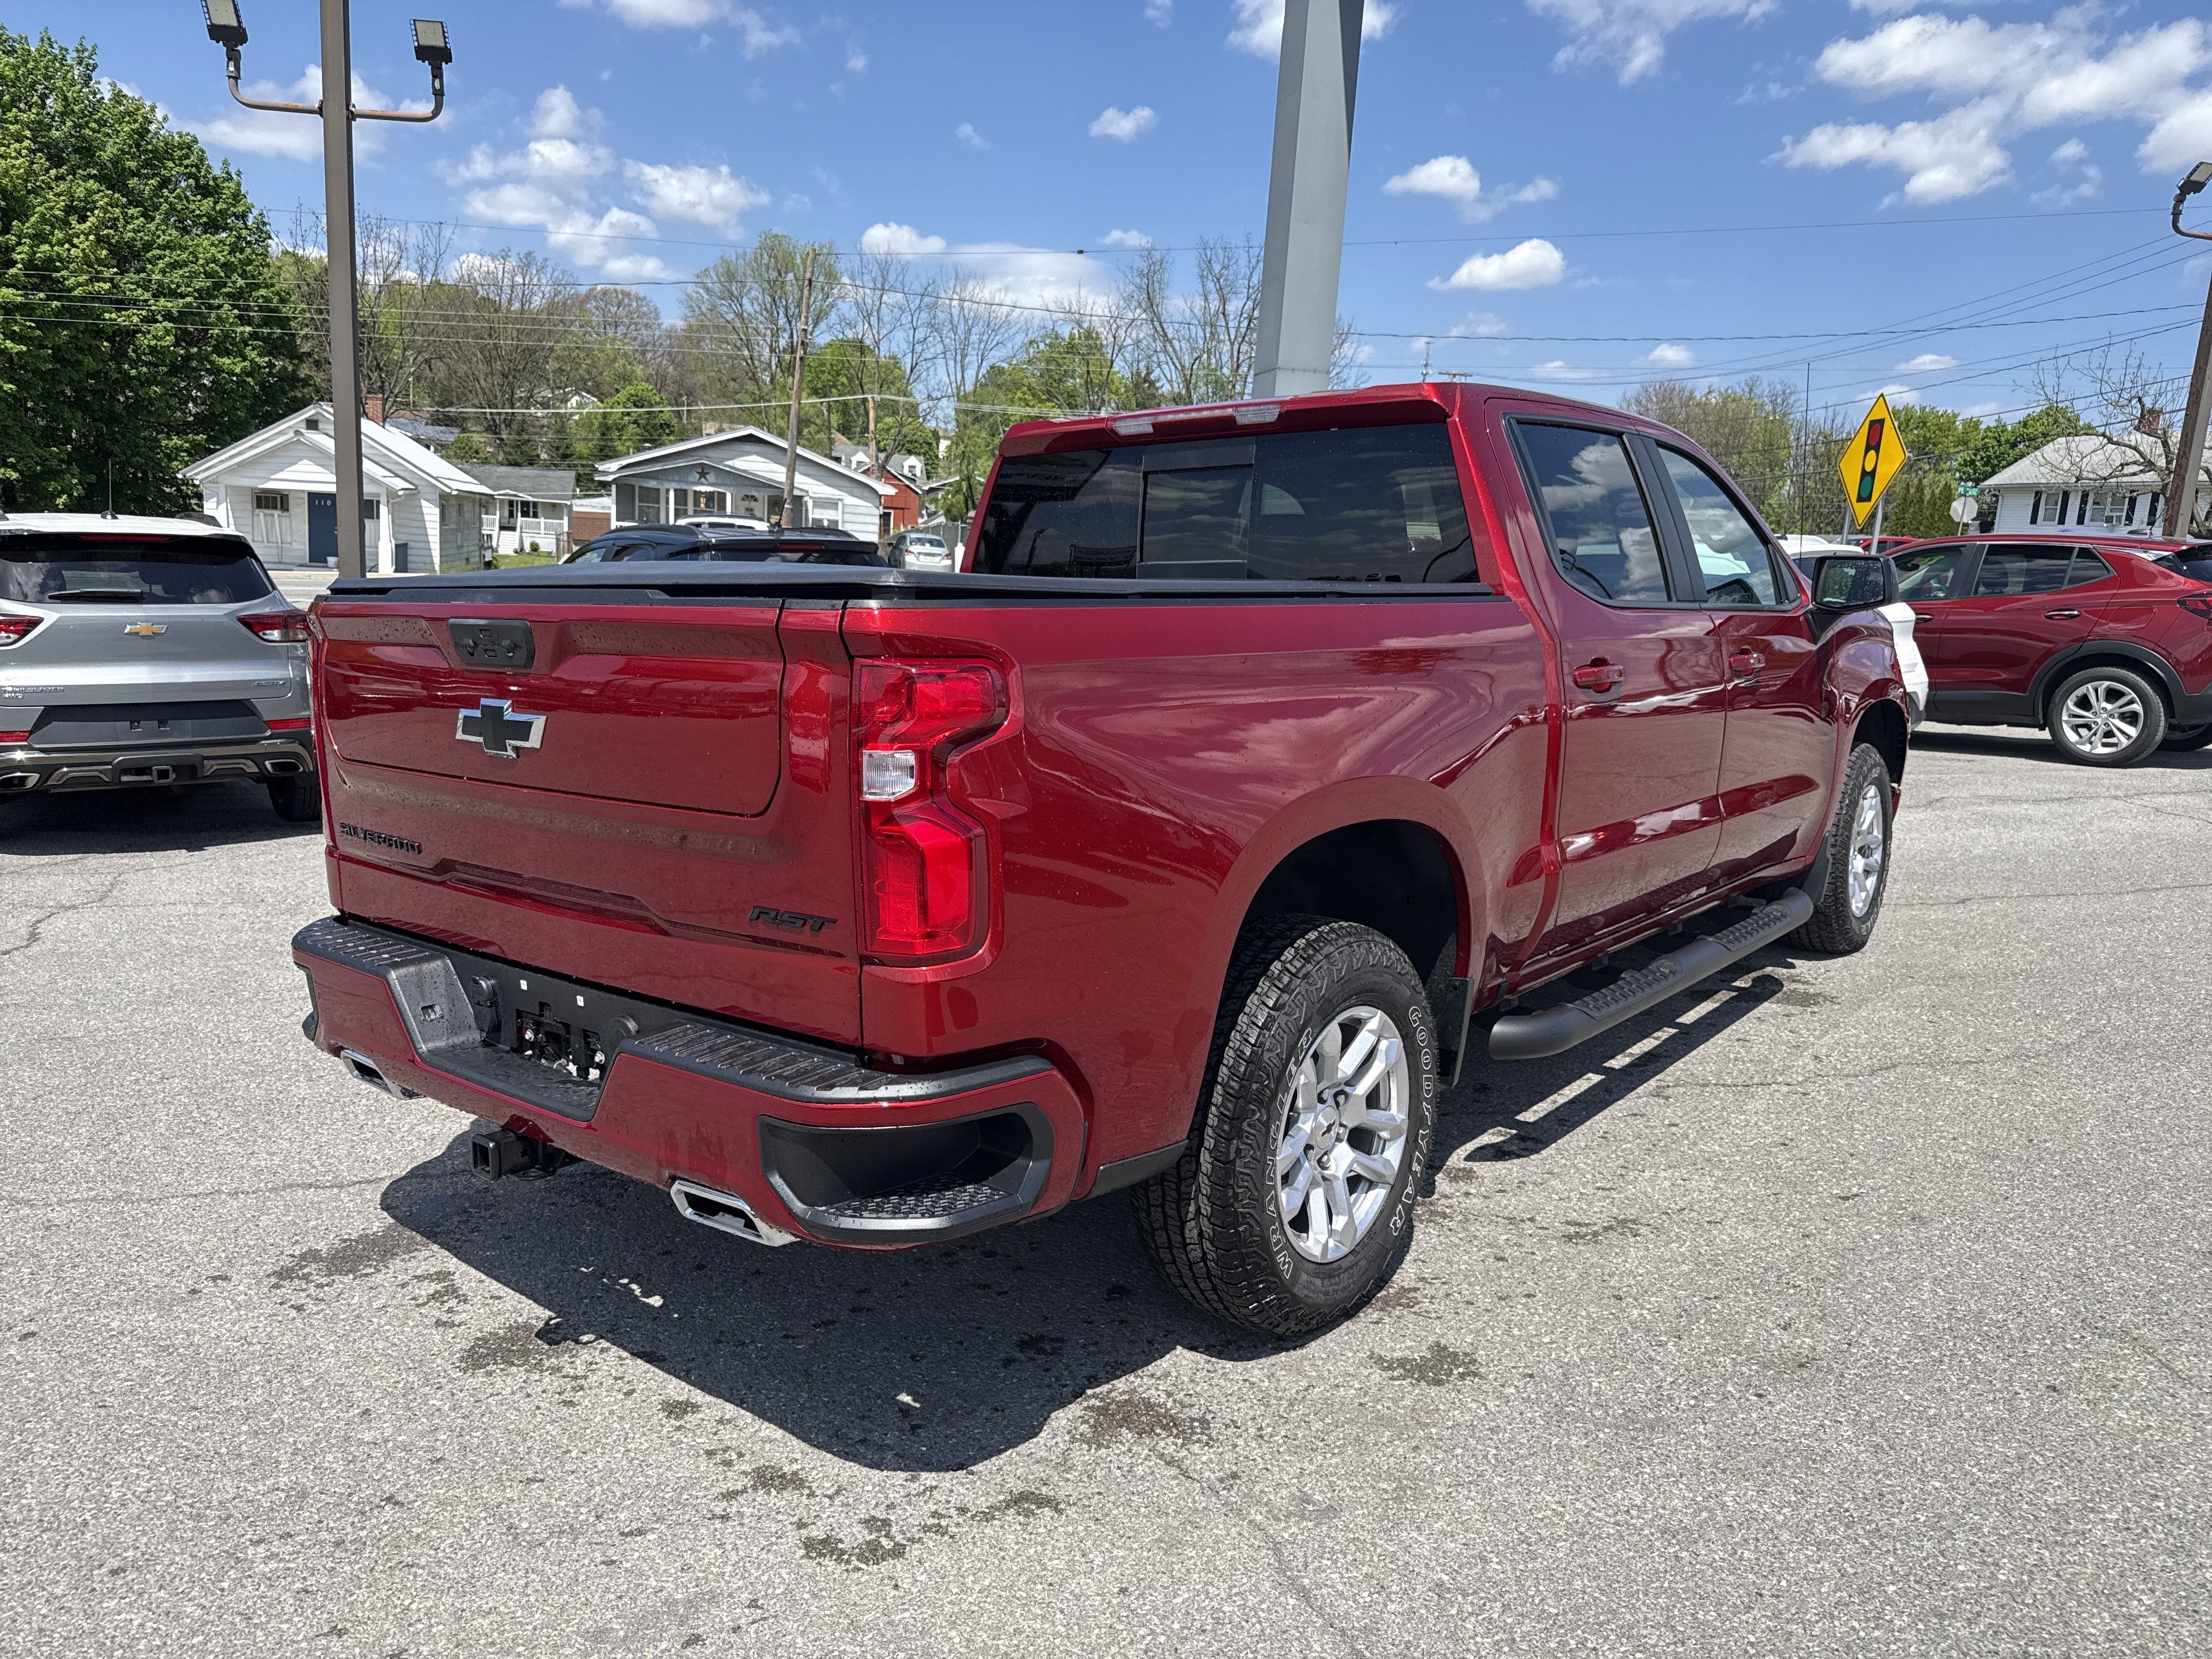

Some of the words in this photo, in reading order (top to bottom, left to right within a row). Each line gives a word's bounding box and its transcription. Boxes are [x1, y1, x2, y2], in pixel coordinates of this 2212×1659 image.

[339, 822, 423, 855] SILVERADO
[748, 905, 839, 933] RST
[1266, 1028, 1312, 1279] WRANGLER
[1389, 1006, 1434, 1236] GOODYEAR
